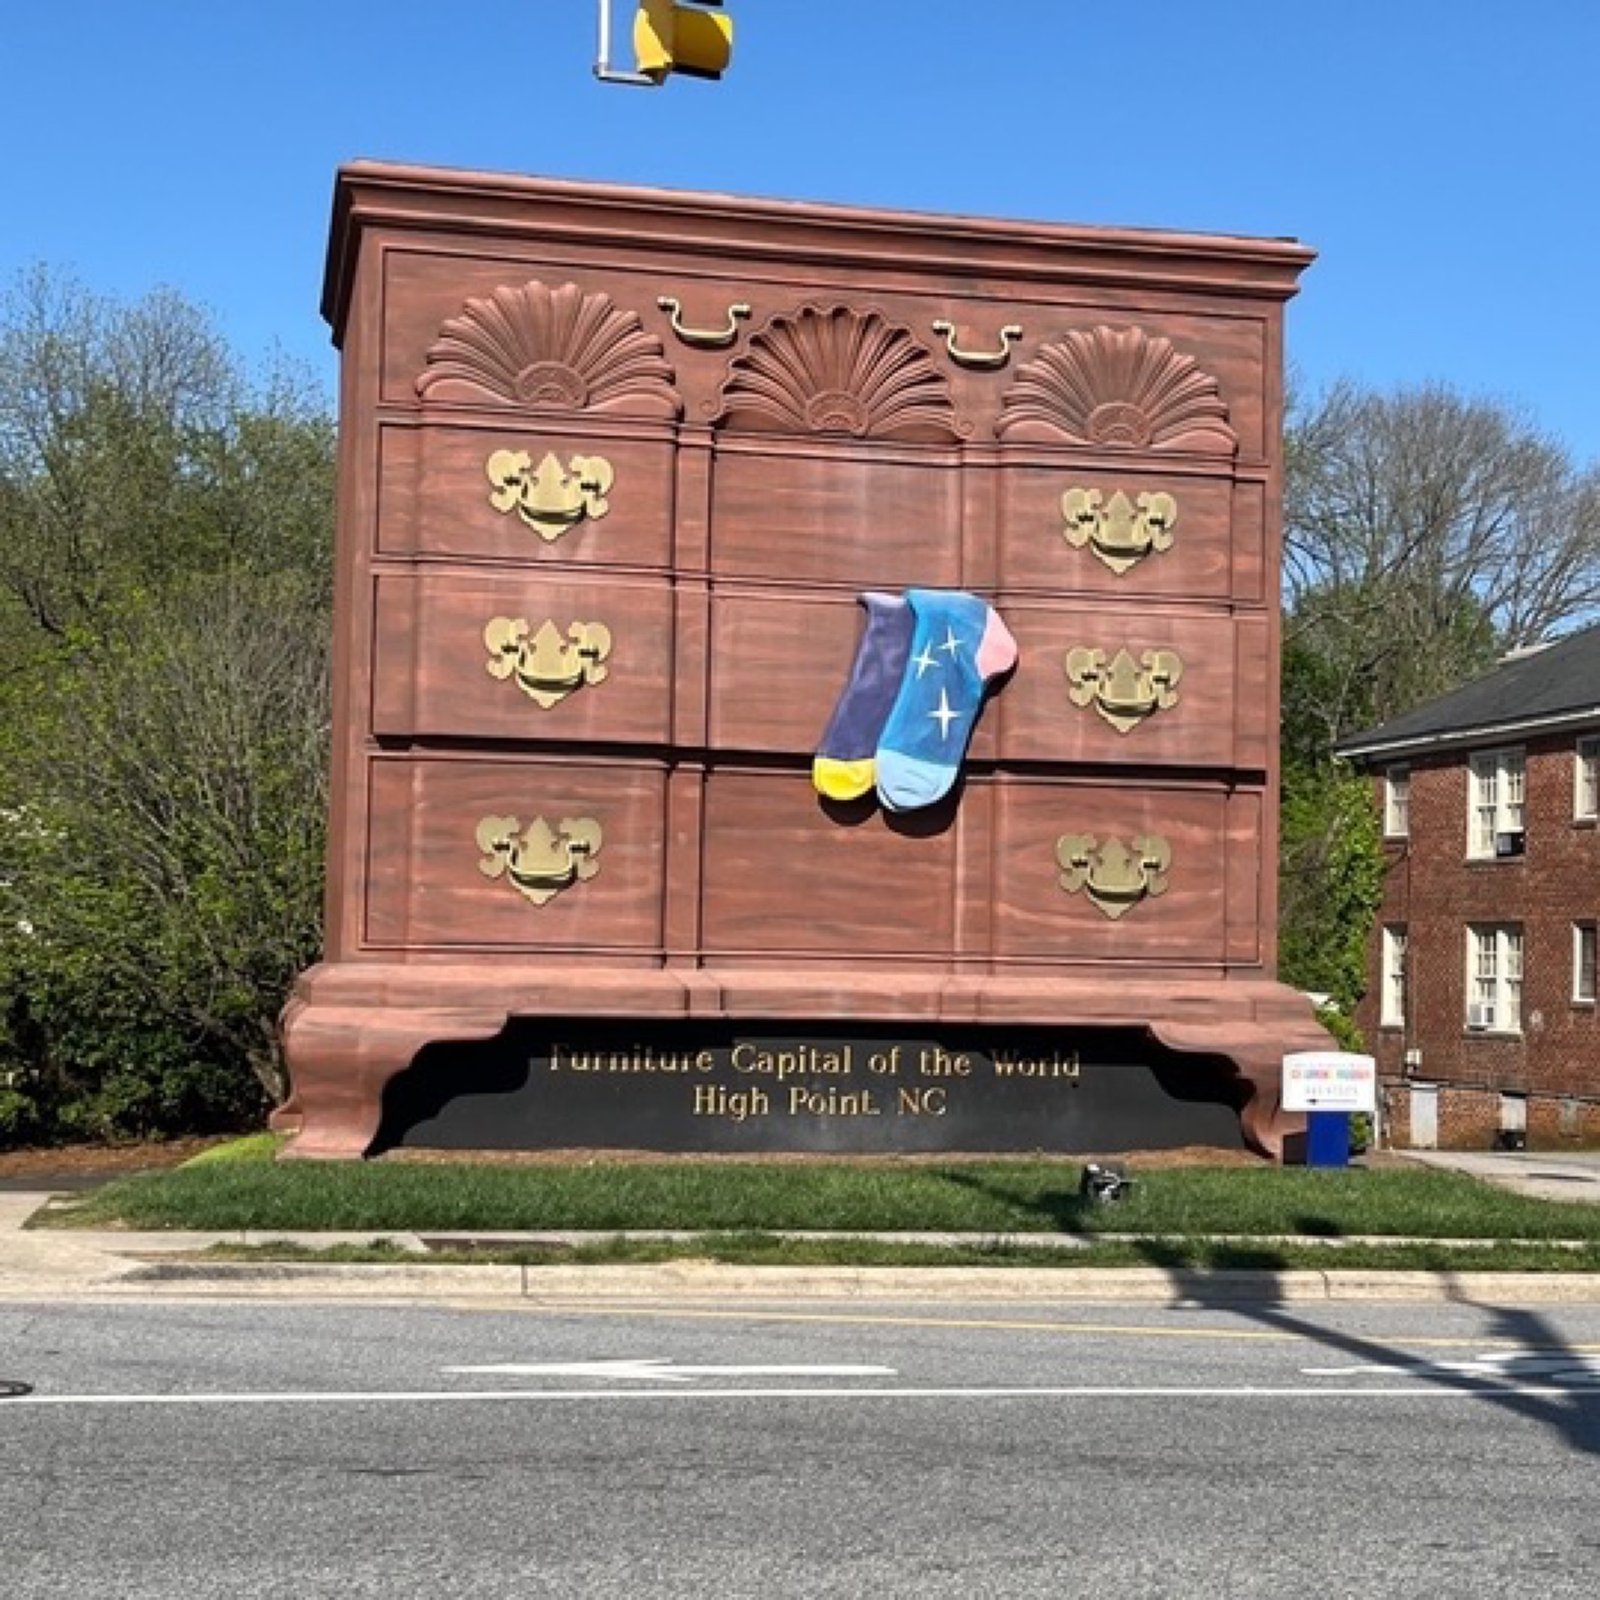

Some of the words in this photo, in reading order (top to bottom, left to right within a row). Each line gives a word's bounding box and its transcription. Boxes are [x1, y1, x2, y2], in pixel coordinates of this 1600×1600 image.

[550, 1043, 713, 1073] Furniture
[731, 1043, 850, 1081] Capital
[868, 1048, 900, 1075] of
[920, 1047, 972, 1077] the
[992, 1049, 1080, 1078] World
[693, 1085, 770, 1122] High
[897, 1087, 947, 1117] NC
